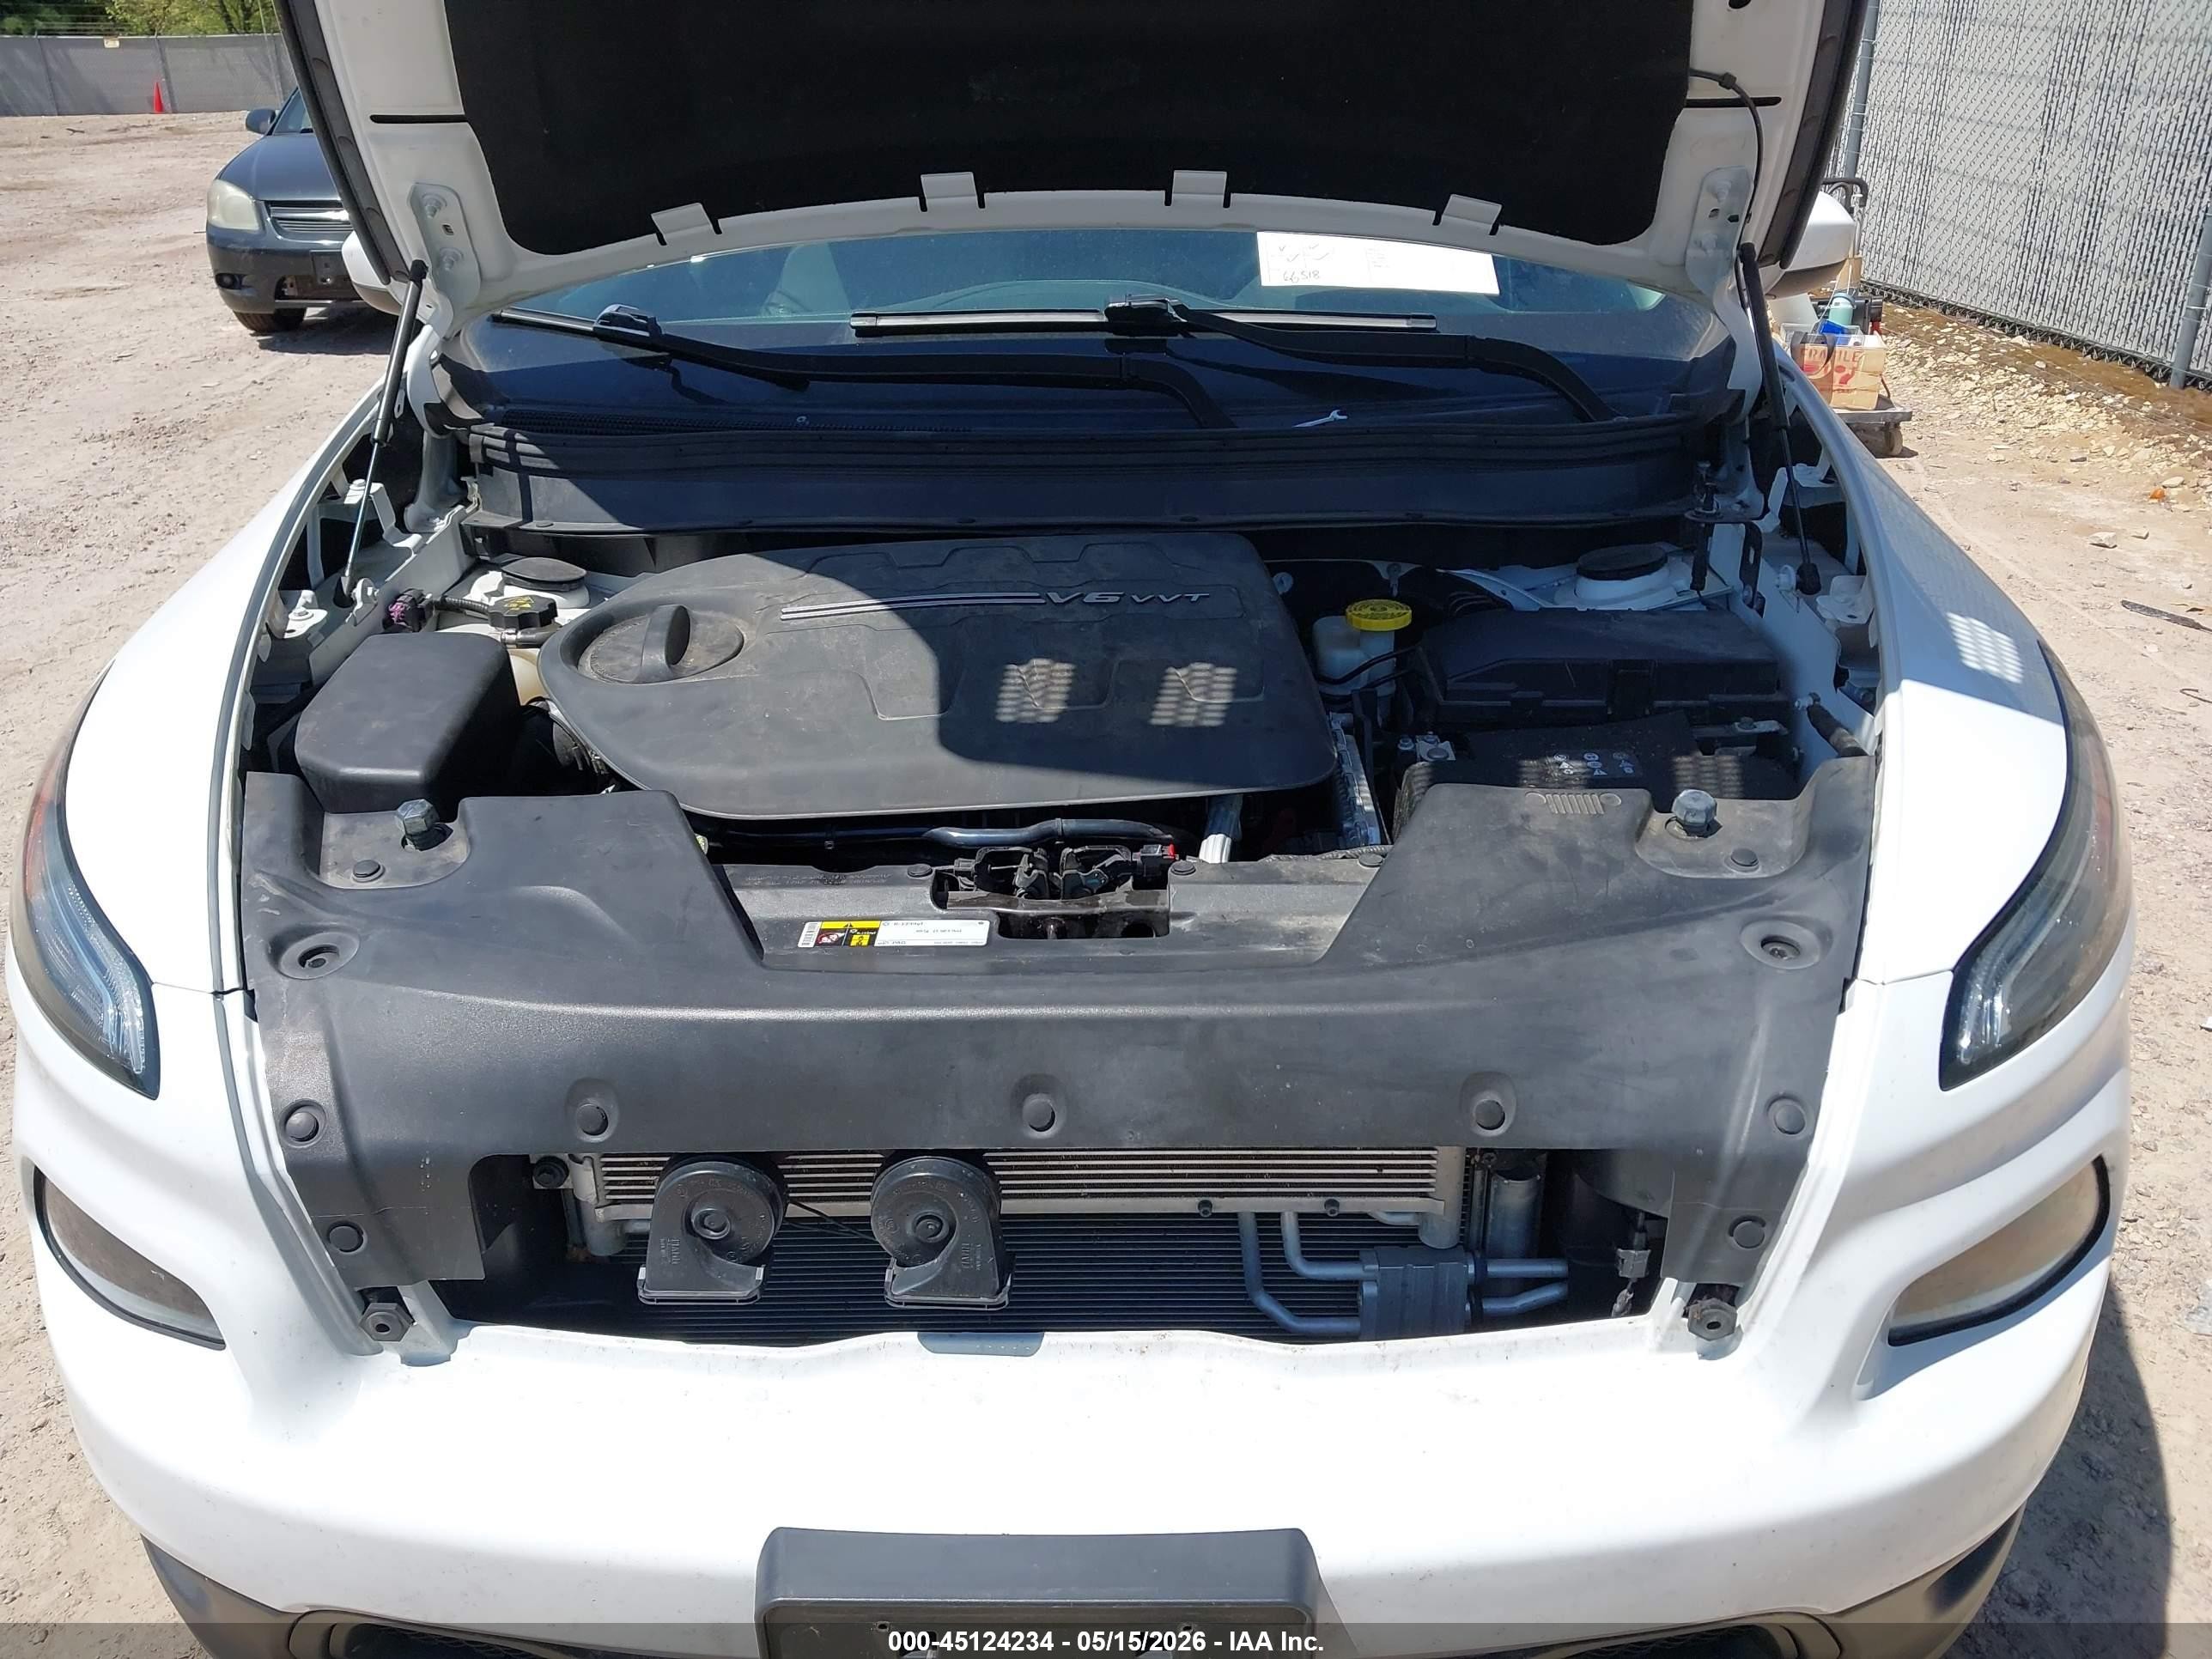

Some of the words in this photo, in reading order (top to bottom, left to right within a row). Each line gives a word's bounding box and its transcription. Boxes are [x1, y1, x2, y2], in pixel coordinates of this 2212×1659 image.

[1800, 348, 1864, 363] FRAILE
[1045, 592, 1125, 604] V6
[1131, 593, 1211, 604] VVT
